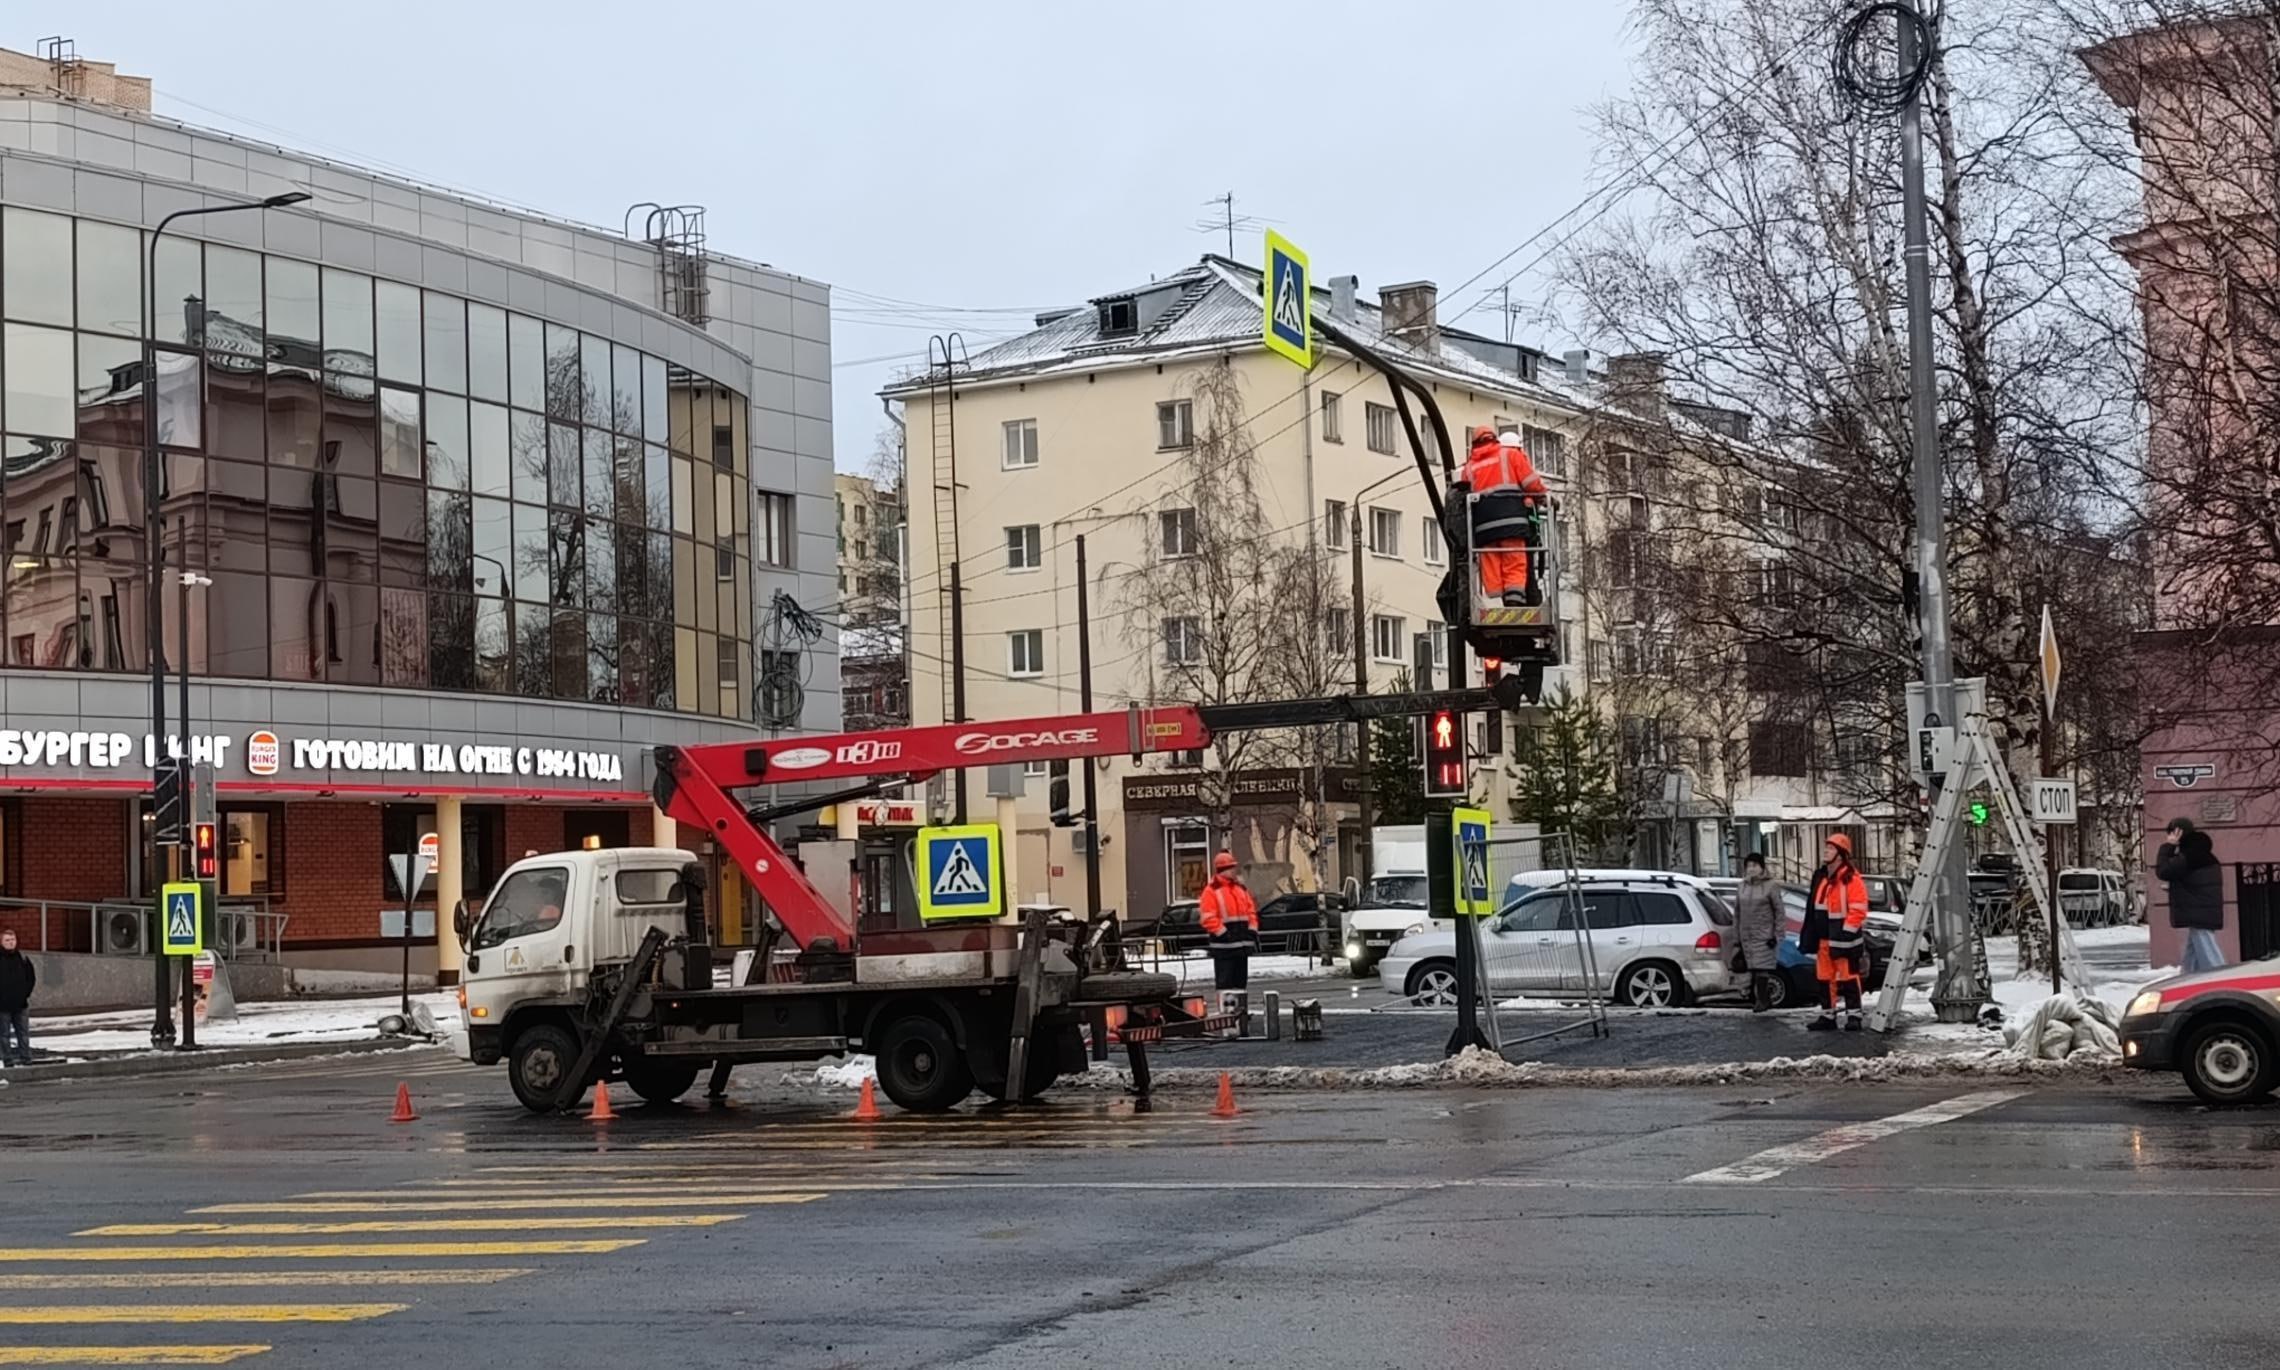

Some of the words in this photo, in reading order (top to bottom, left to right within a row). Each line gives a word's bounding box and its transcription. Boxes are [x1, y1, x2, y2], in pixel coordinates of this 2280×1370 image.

[0, 730, 132, 767] БУРГЕР
[954, 728, 1098, 754] SOCAGE
[251, 754, 276, 764] KING
[293, 738, 416, 771] ГОТОВИМ
[422, 743, 456, 773] НА
[459, 745, 513, 774] ОГНЕ
[517, 747, 531, 775] С
[536, 749, 576, 777] 1954
[578, 751, 622, 781] ГОДА
[1126, 783, 1197, 799] СЕВЕРНАЯ
[2040, 787, 2070, 813] СТОП
